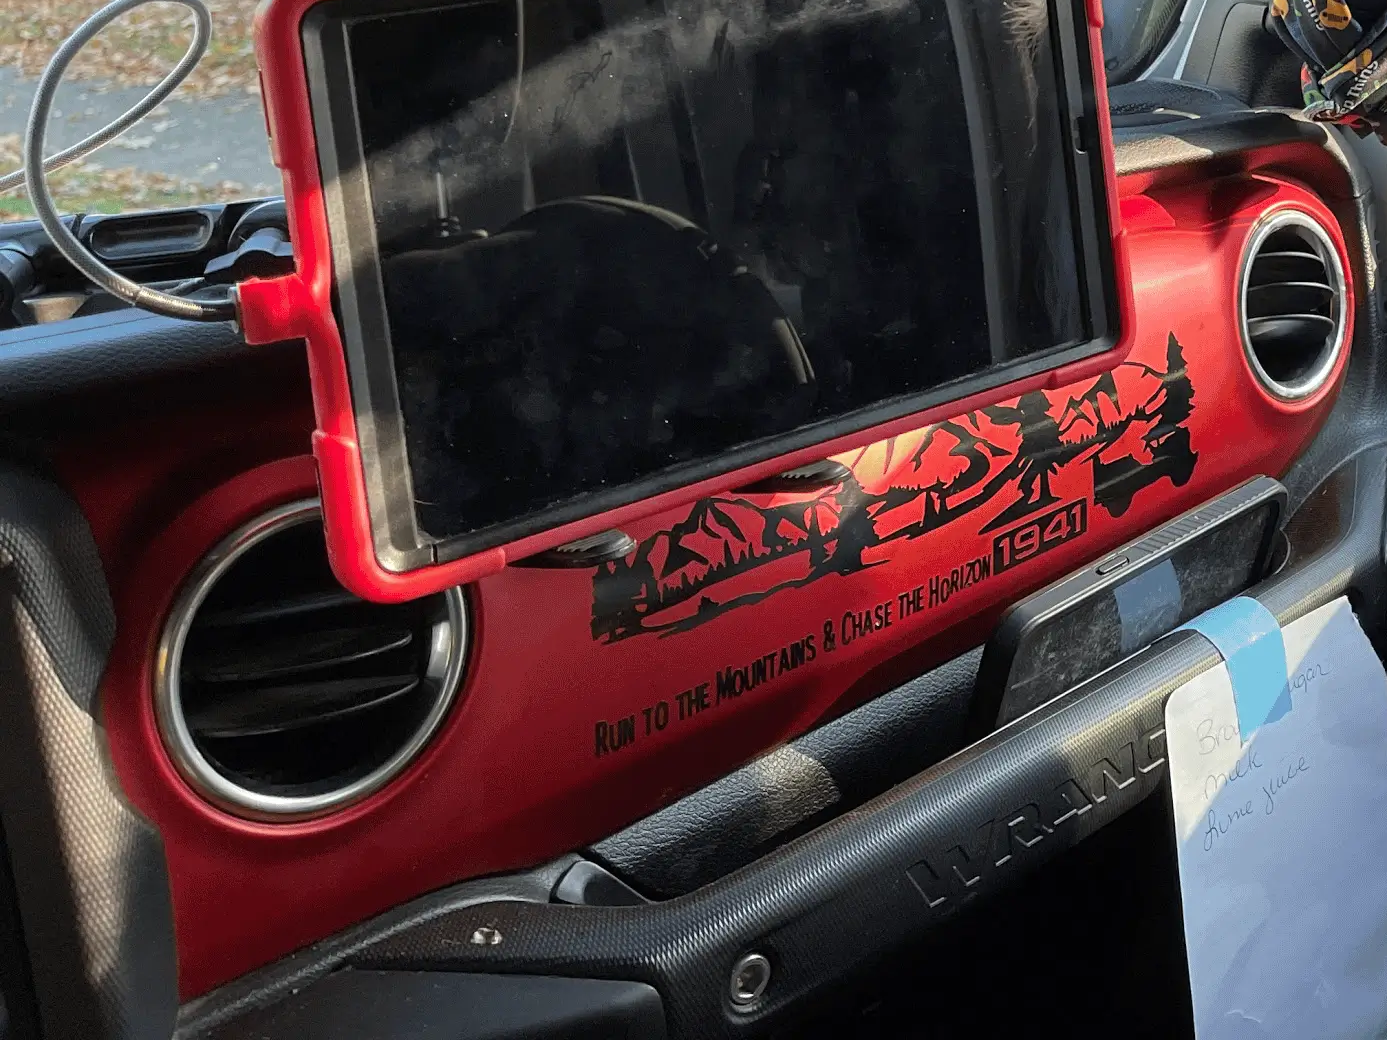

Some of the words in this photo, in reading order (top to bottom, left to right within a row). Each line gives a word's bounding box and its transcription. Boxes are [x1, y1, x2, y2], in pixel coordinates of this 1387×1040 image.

[998, 504, 1089, 568] 1941
[675, 681, 711, 721] THE
[822, 618, 837, 653] &
[898, 584, 925, 620] THE
